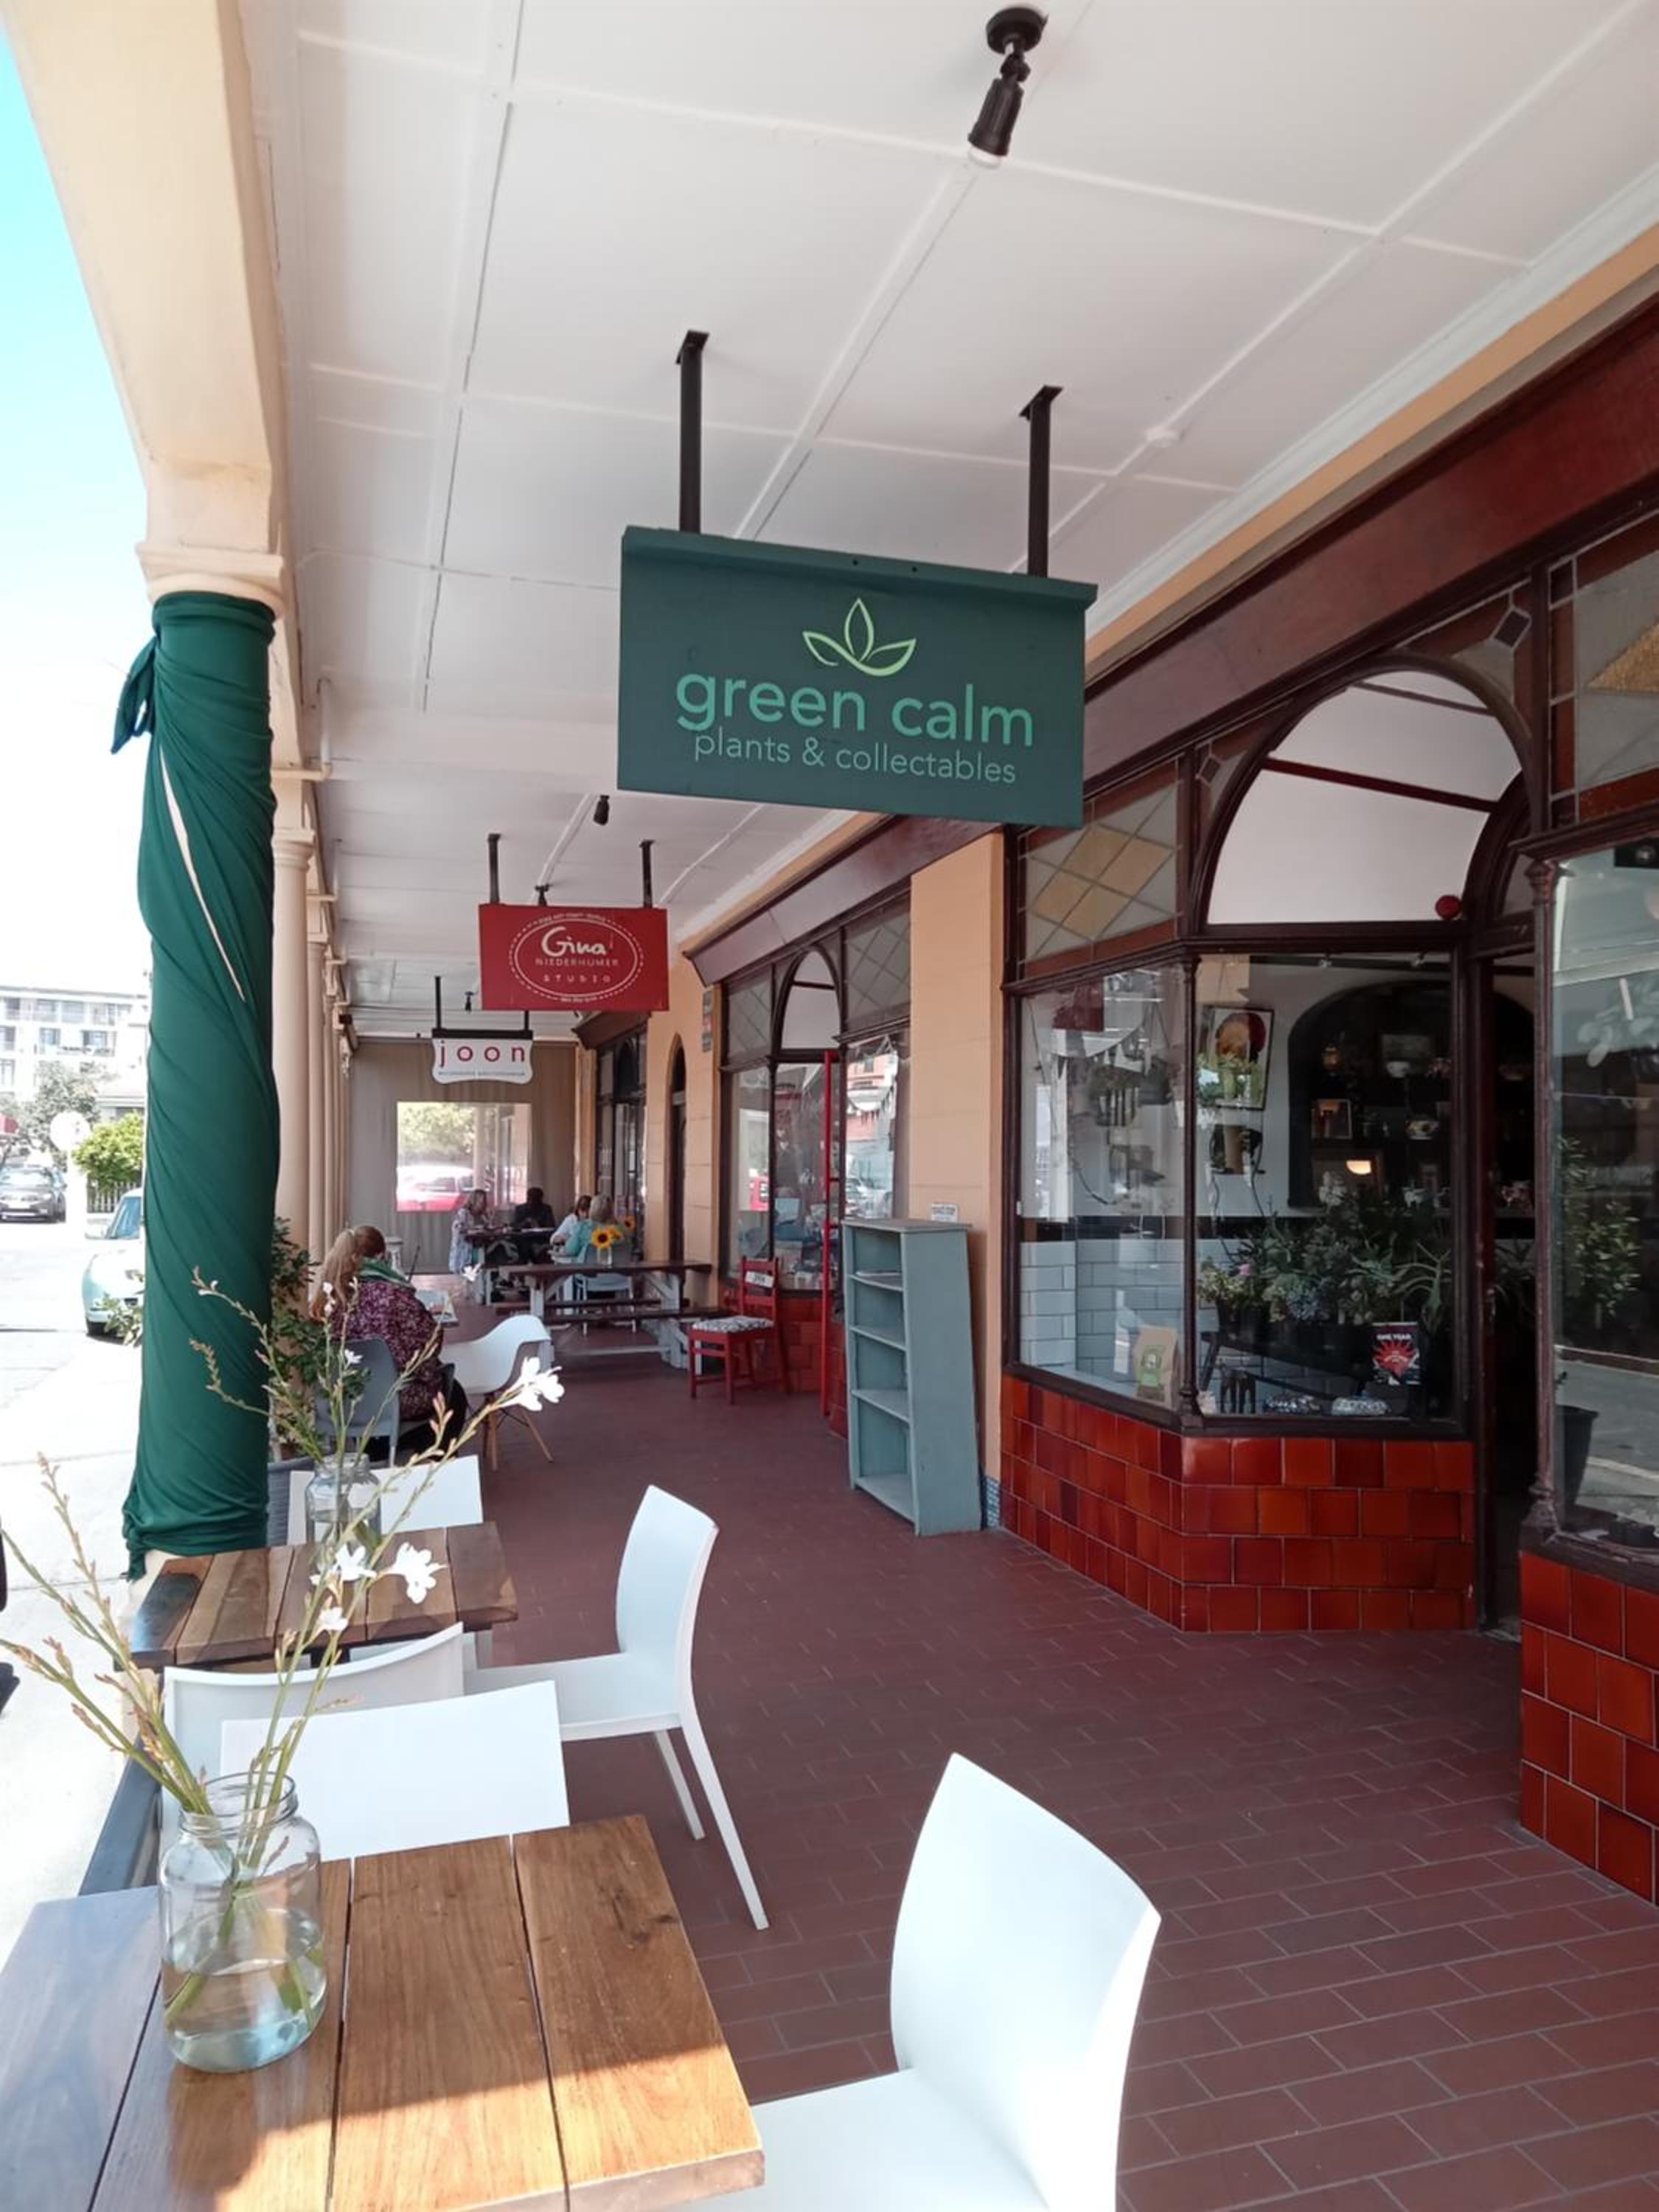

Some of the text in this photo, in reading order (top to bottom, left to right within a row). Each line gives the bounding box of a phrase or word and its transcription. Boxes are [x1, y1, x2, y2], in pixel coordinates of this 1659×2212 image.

[677, 672, 1033, 746] green calm
[695, 727, 1017, 784] plants & collectables
[541, 926, 607, 957] Gina
[543, 974, 611, 984] STUDIO
[440, 1040, 524, 1068] joon
